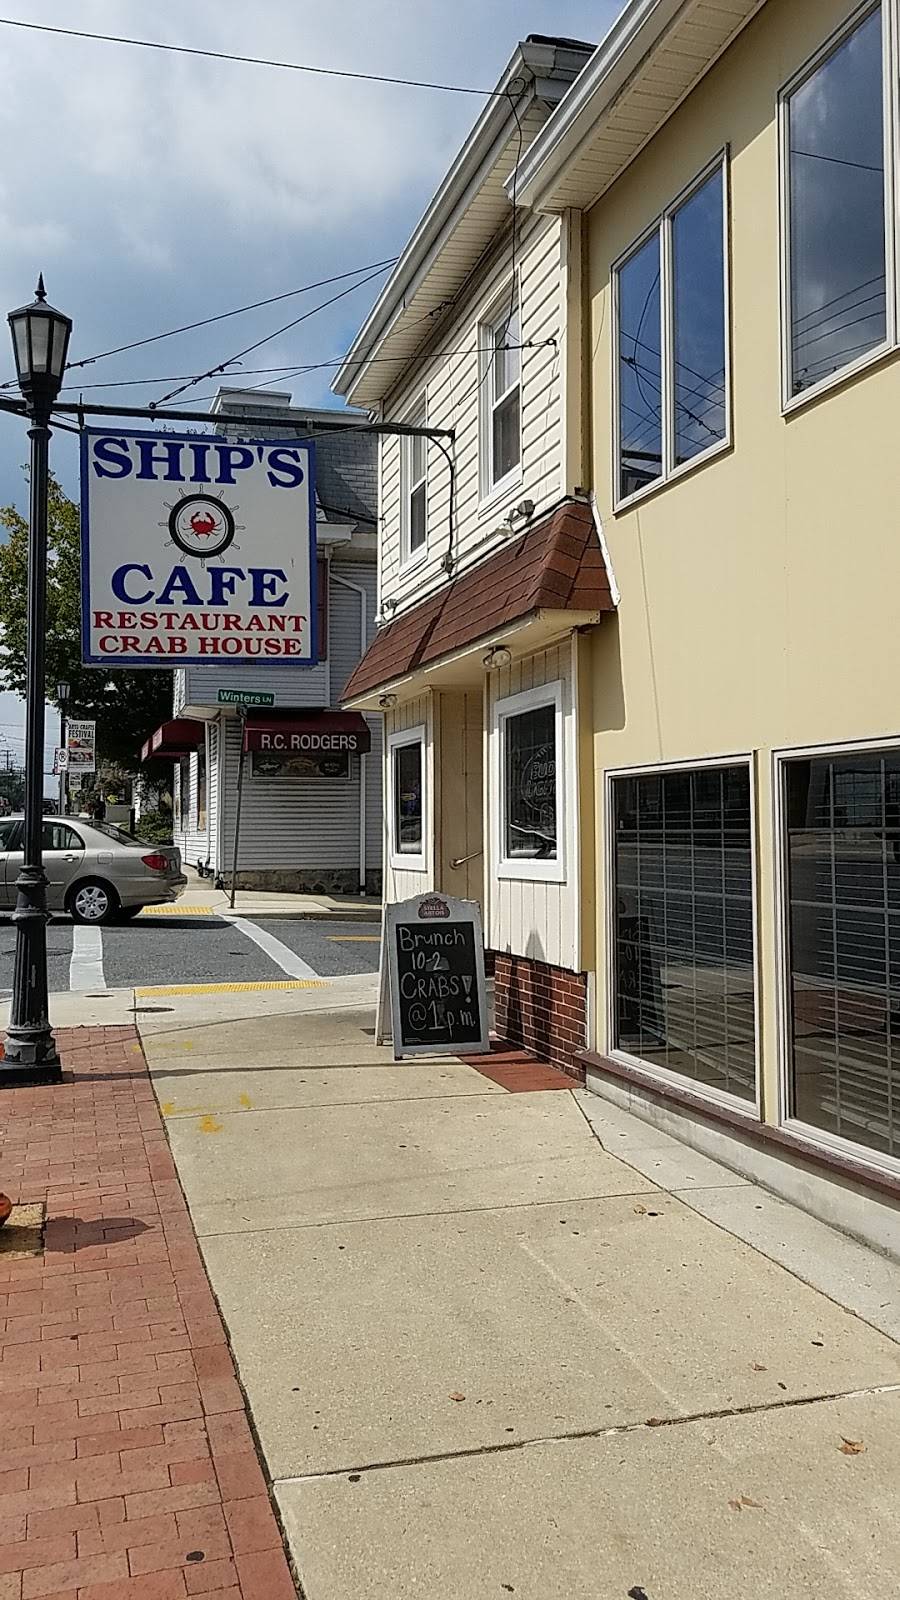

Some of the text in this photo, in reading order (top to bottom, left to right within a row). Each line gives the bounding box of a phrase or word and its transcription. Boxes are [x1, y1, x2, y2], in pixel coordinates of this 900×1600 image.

[92, 437, 304, 488] SHIP'S
[111, 563, 290, 607] CAFE
[93, 611, 307, 633] RESTAURANT
[99, 635, 302, 655] CRAB HOUSE
[219, 691, 261, 704] Winters
[69, 730, 94, 738] FESTIVAL
[261, 734, 357, 750] R.C. RODGERS
[400, 926, 466, 951] Brunch
[412, 951, 443, 970] 10-2
[400, 972, 473, 1003] CRABS!
